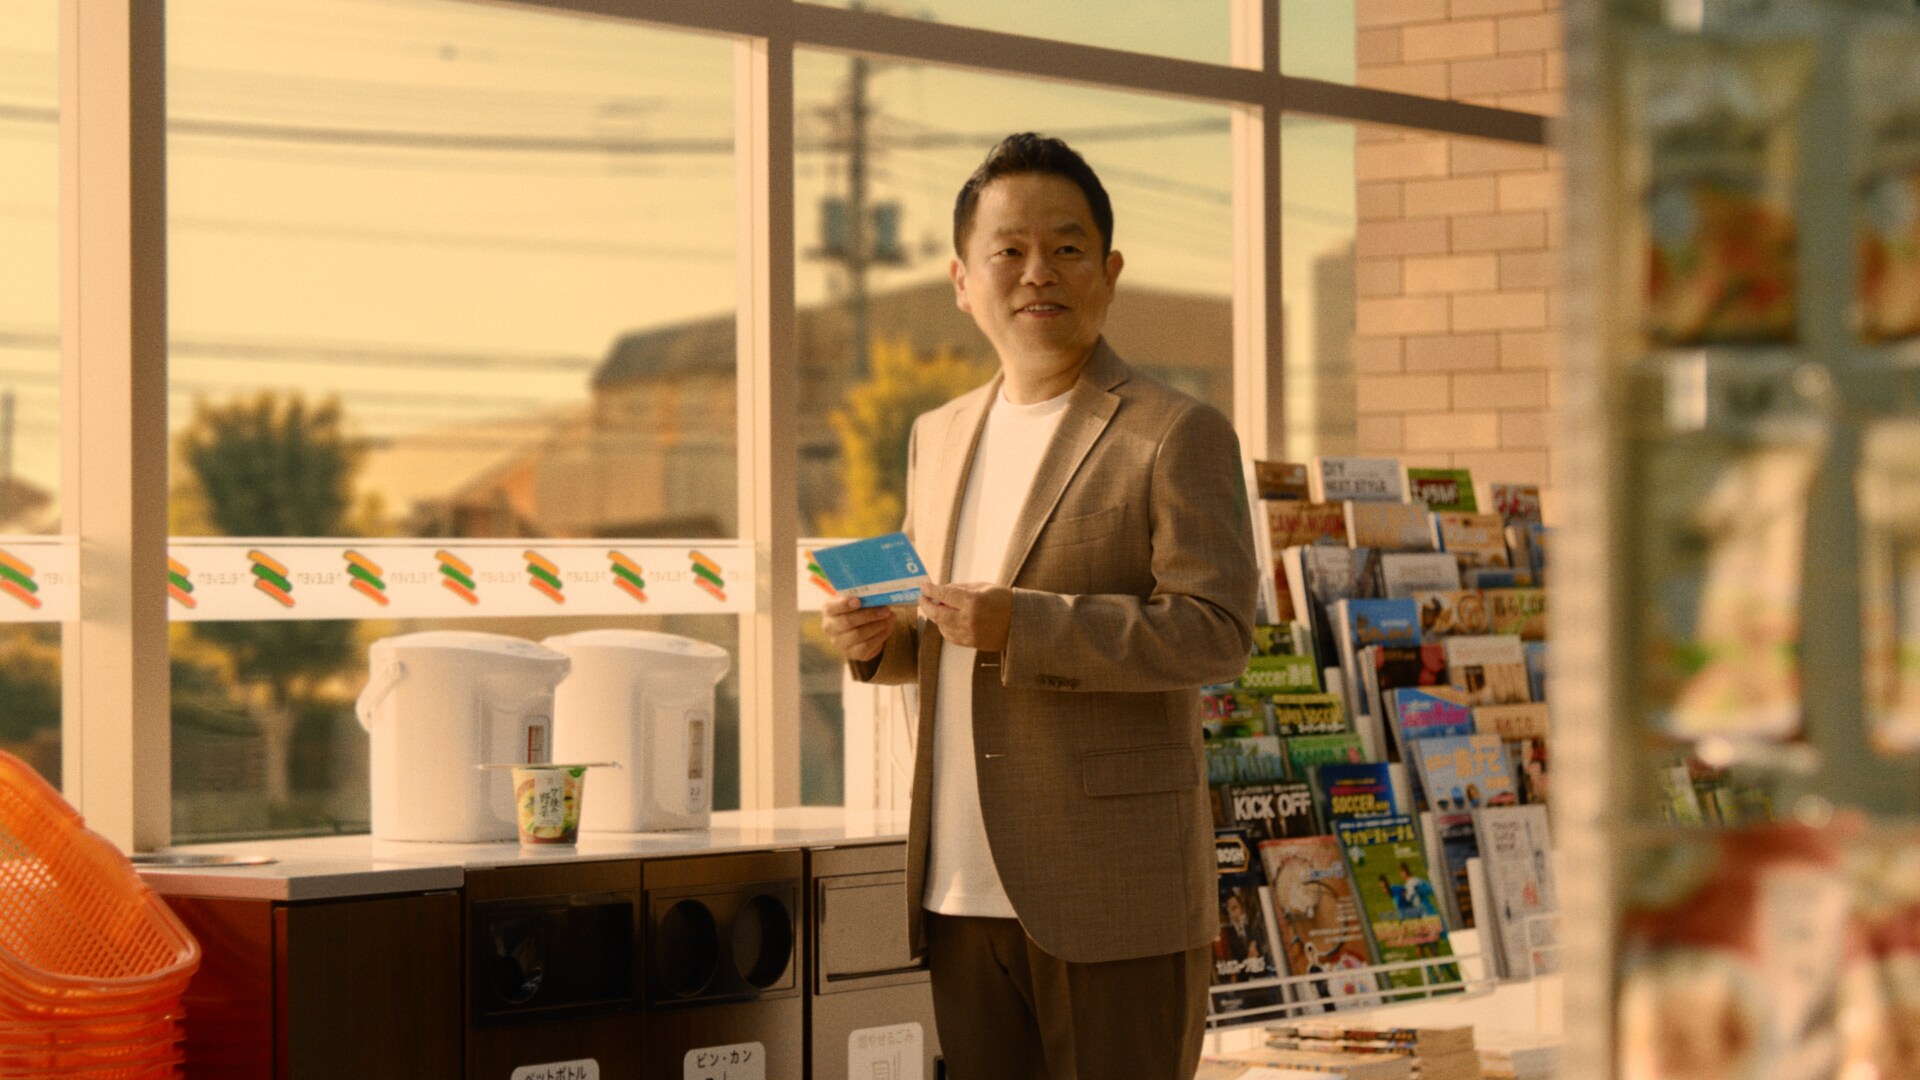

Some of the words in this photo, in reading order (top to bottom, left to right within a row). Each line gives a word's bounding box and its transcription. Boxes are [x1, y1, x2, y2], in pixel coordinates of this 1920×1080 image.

[1233, 795, 1275, 821] KICK
[1277, 791, 1311, 818] OFF
[1331, 794, 1375, 814] SOCCER
[697, 1049, 752, 1069] ビン・カン
